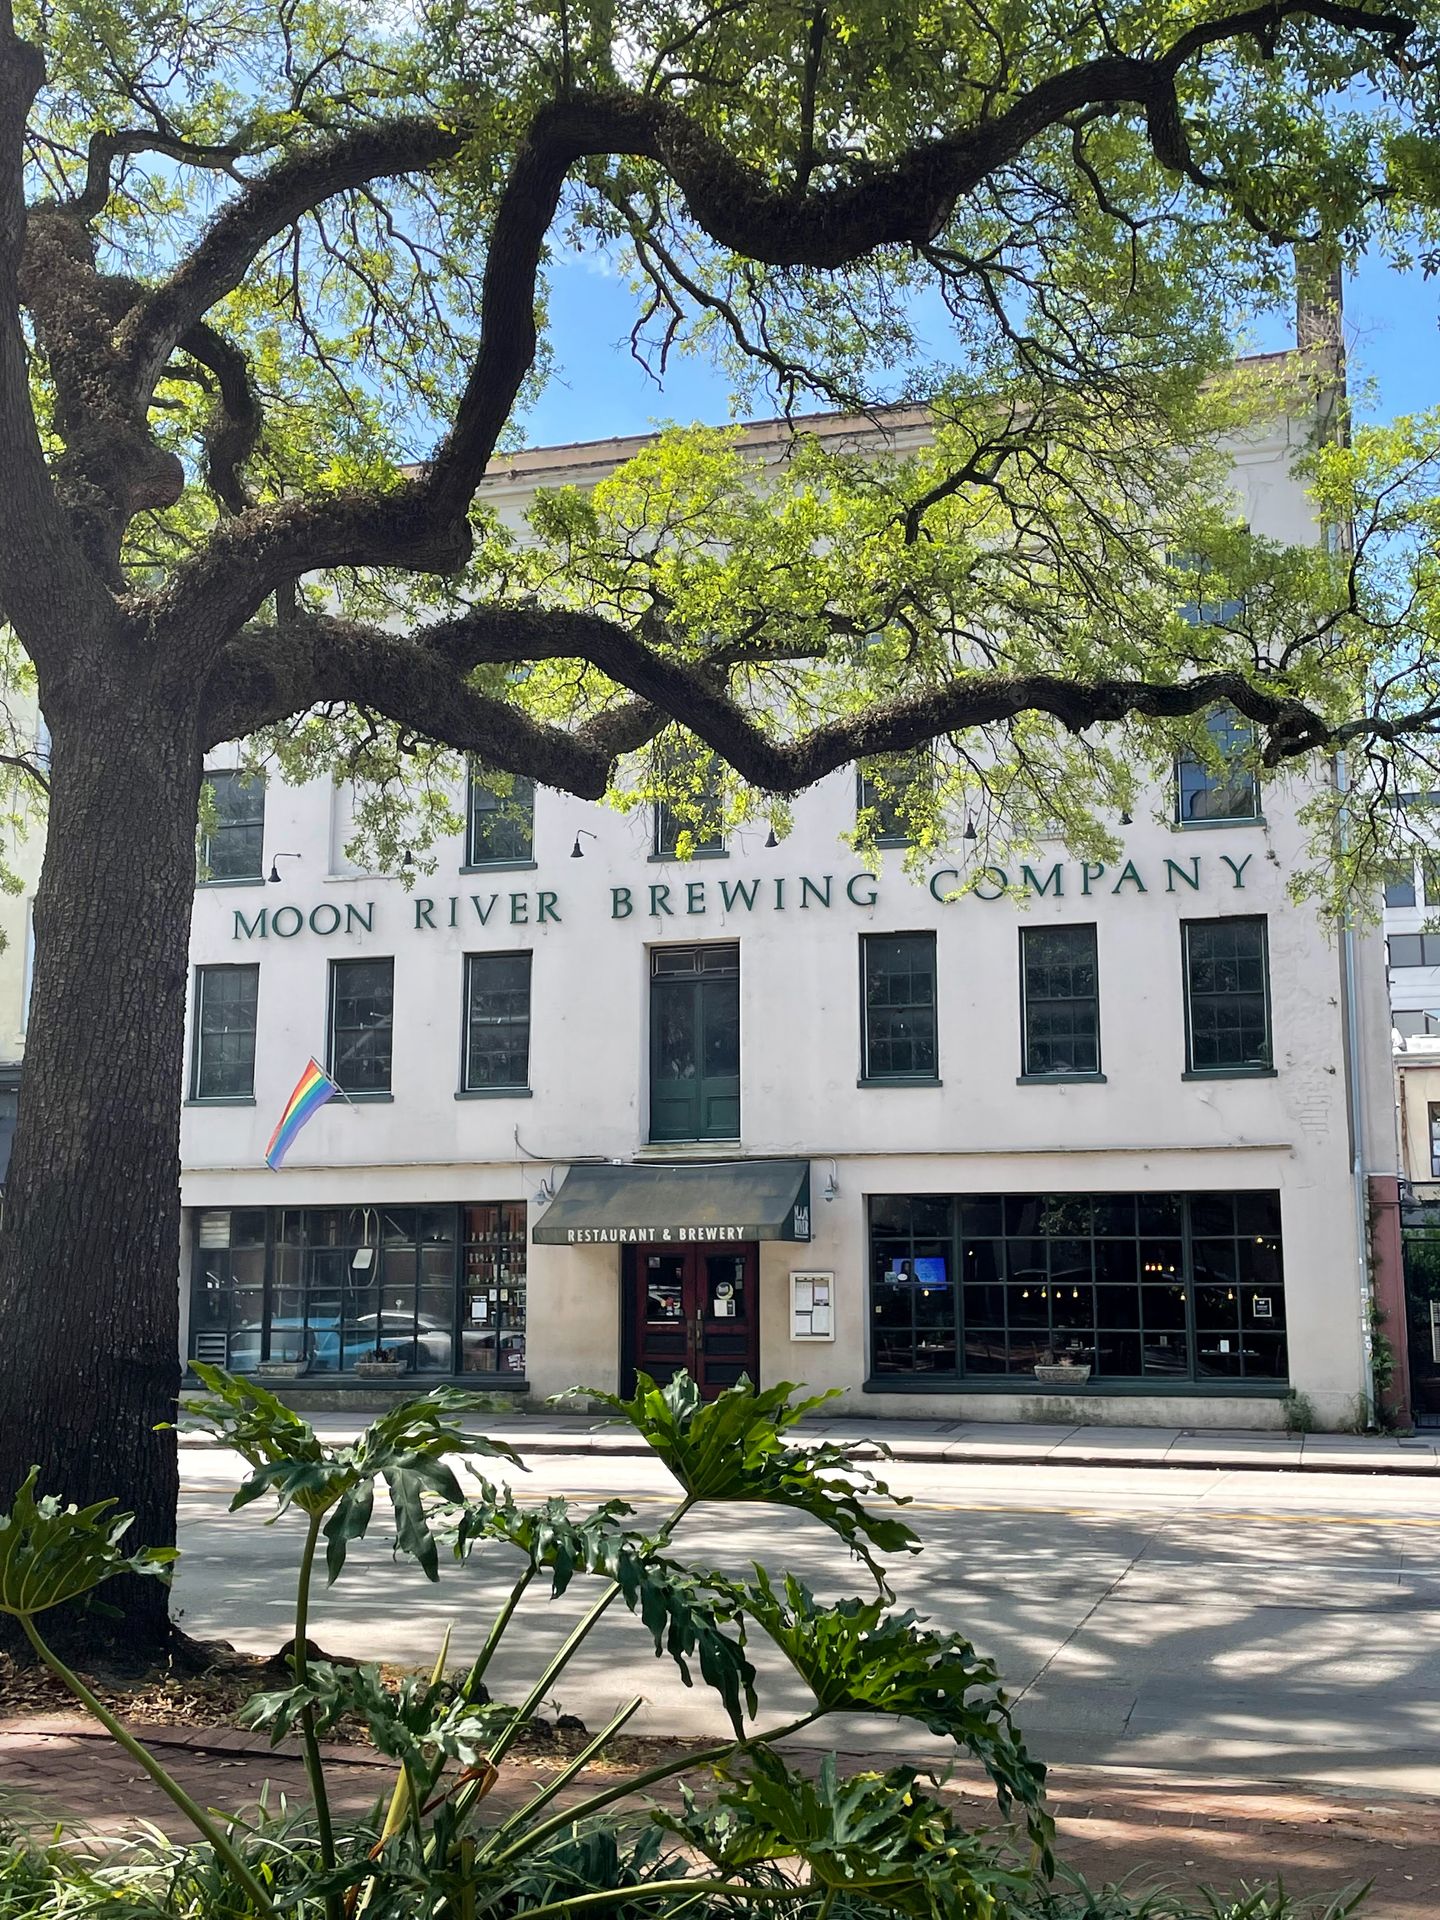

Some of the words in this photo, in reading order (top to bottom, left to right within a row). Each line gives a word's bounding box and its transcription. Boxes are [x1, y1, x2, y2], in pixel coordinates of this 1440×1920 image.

[232, 902, 374, 939] MOON
[414, 891, 562, 930] RIVER
[610, 874, 879, 919] BREWING
[929, 854, 1253, 903] COMPANY
[567, 1228, 655, 1242] RESTAURANT
[662, 1228, 672, 1241] &
[679, 1226, 744, 1241] BREWERY
